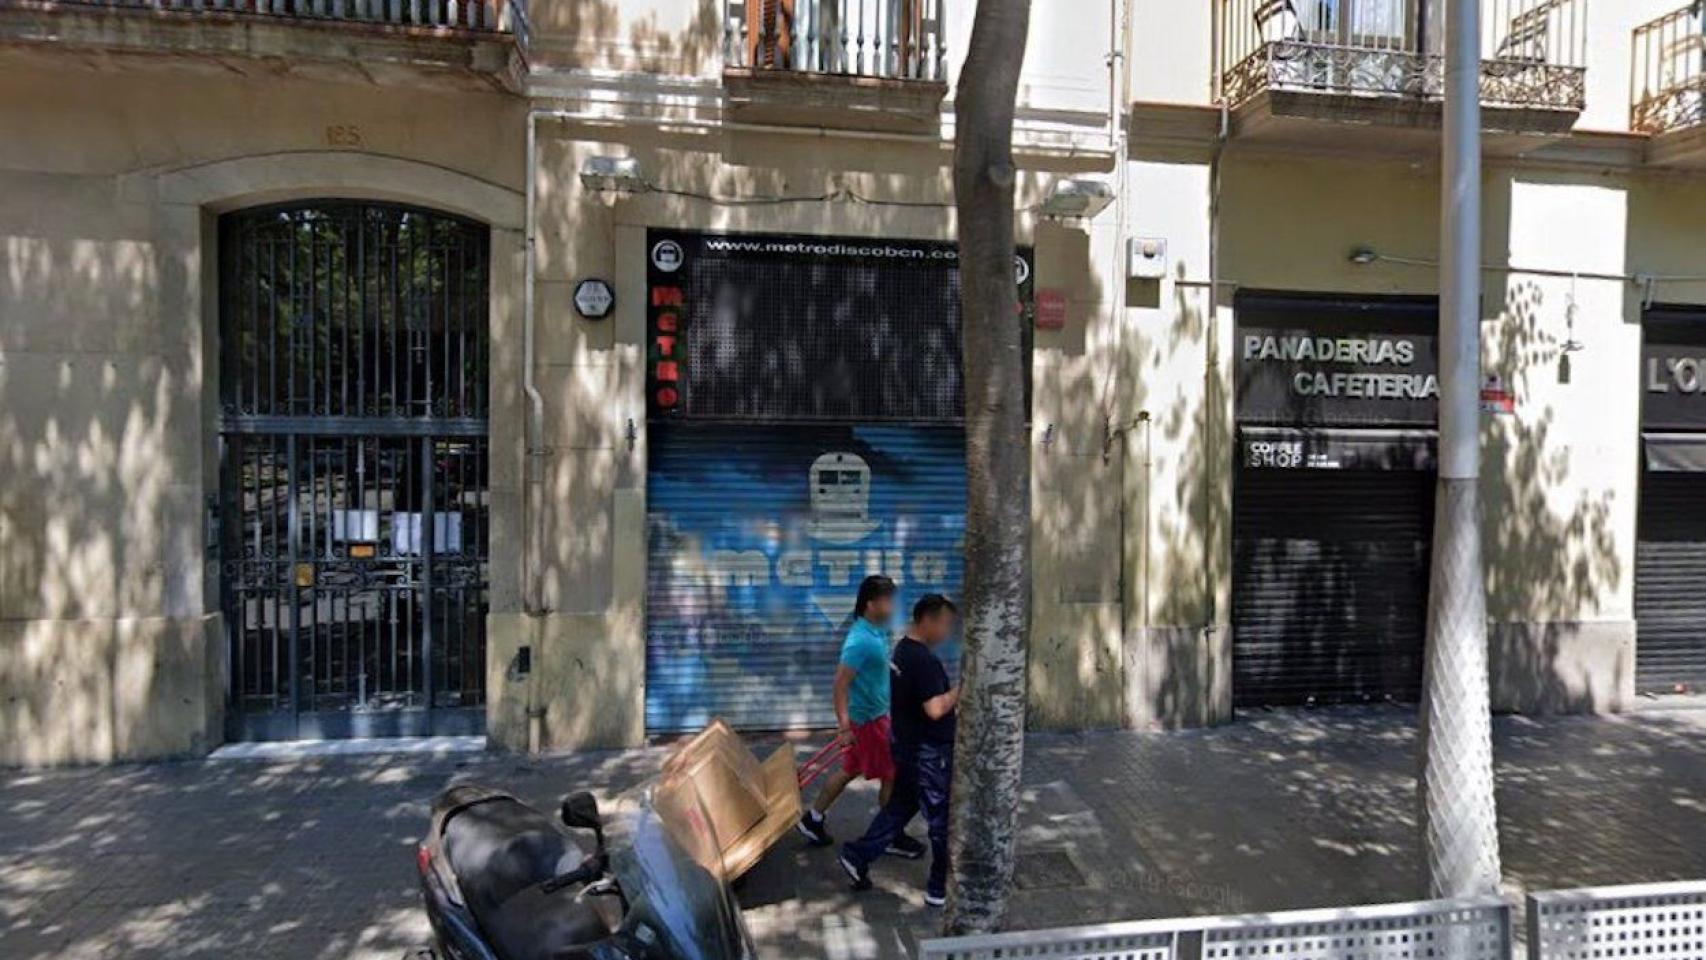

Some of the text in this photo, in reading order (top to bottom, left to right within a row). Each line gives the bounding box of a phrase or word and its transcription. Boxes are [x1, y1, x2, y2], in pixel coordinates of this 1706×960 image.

[707, 240, 959, 259] www.metrodiscobcn.co
[1243, 335, 1415, 364] PANADERIAS
[1294, 371, 1440, 398] CAFETERIA
[1646, 357, 1706, 393] L'O
[1250, 452, 1302, 468] SHOP
